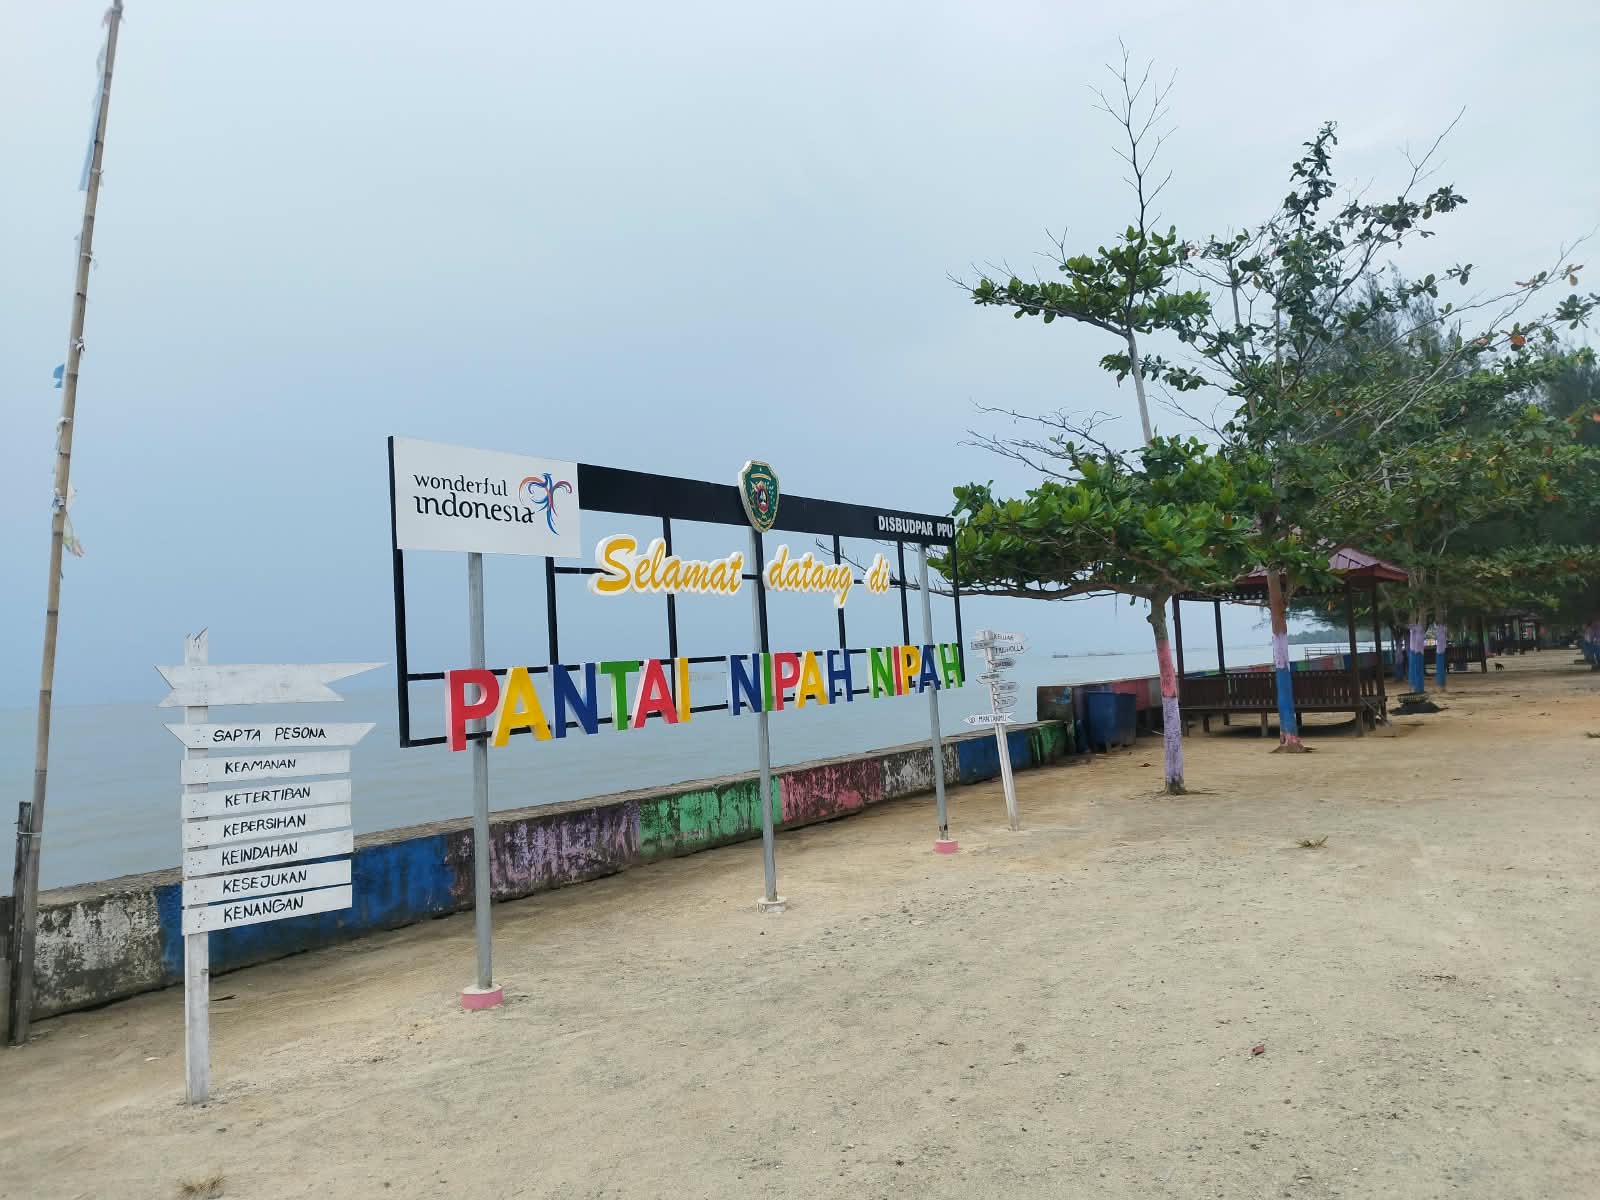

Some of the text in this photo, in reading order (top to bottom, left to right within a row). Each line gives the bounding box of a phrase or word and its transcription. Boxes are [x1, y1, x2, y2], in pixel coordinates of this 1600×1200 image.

[413, 474, 509, 497] wonderful
[413, 492, 536, 524] indonesia
[878, 515, 953, 538] DISBUDPAR PPU
[595, 538, 890, 606] Selamat datang di
[444, 642, 964, 752] PANTAI NIPAH NIPAH
[212, 727, 327, 742] SAPTA PESONA
[225, 758, 296, 774] KEAMANAN
[225, 786, 311, 808] KETERTIBAN
[223, 813, 306, 837] KEBERSIHAN
[221, 842, 299, 866] KEINDAHAN
[222, 869, 307, 895] KESEJUKAN
[223, 895, 304, 923] KENANGAN
